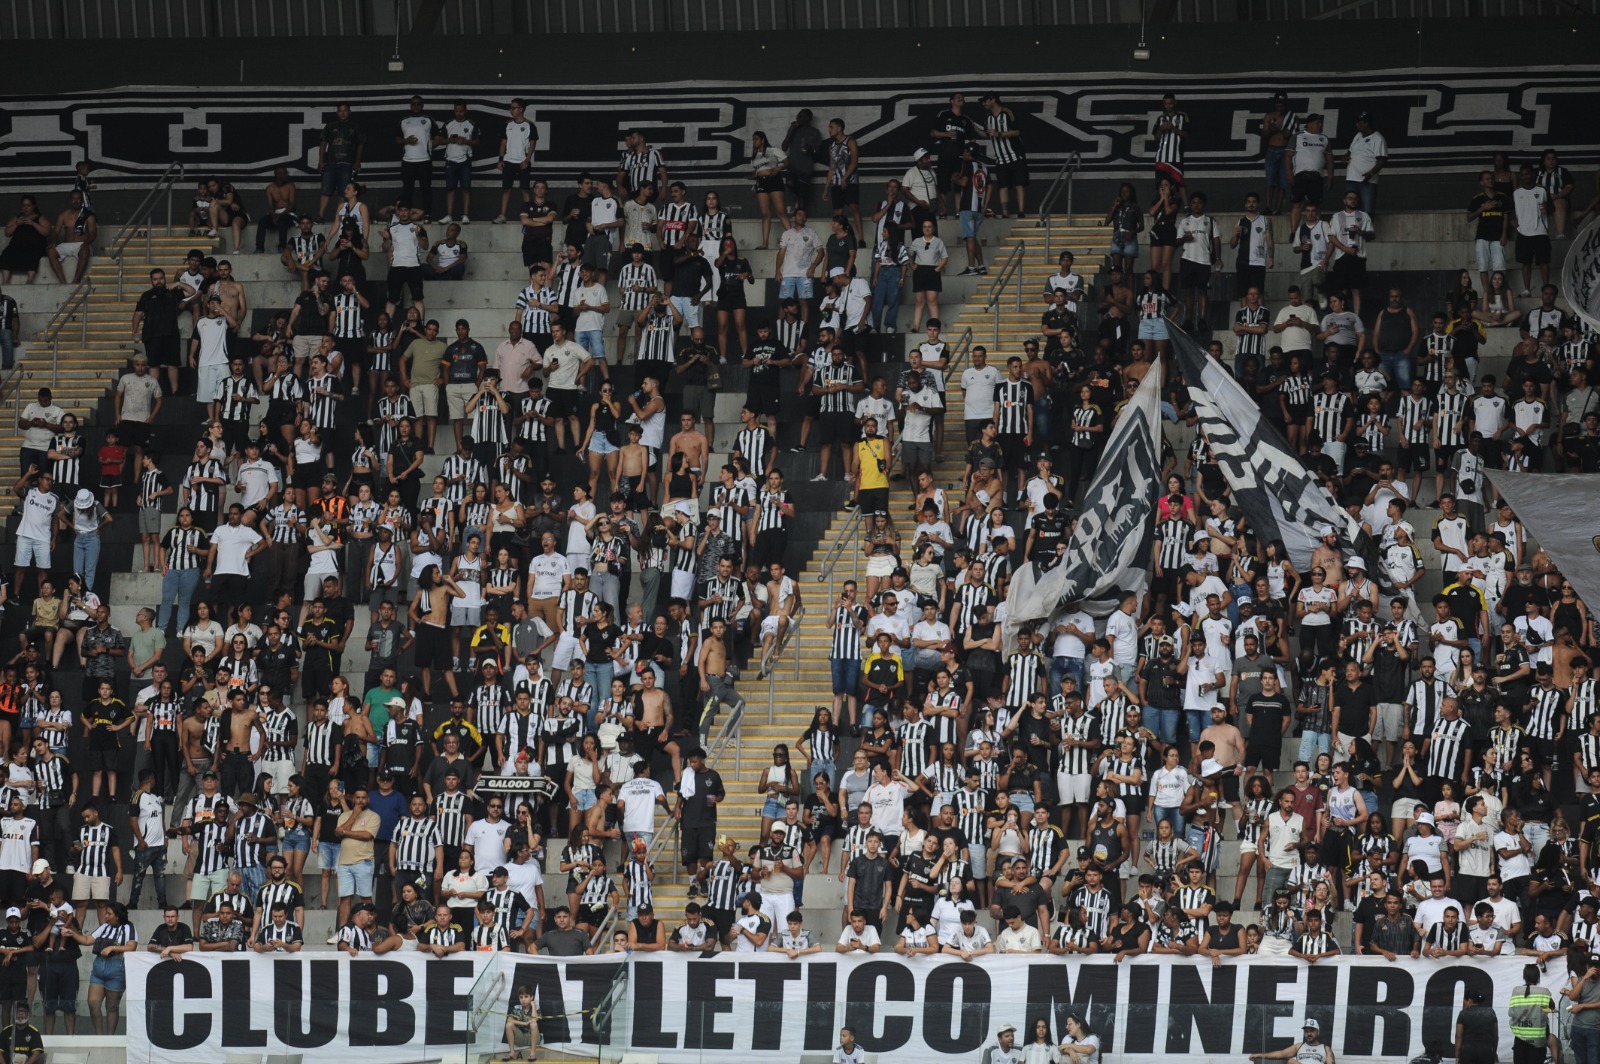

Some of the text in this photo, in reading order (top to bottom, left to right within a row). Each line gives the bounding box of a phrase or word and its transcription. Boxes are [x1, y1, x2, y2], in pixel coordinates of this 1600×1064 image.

[1143, 303, 1157, 312] FIAT
[34, 503, 52, 511] BETANO
[488, 779, 530, 788] GALOOO
[755, 808, 762, 817] H
[3, 832, 24, 840] CAIXA
[145, 952, 1494, 1058] CLUBE ATLÉTICO MINEIRO
[517, 1052, 523, 1060] A
